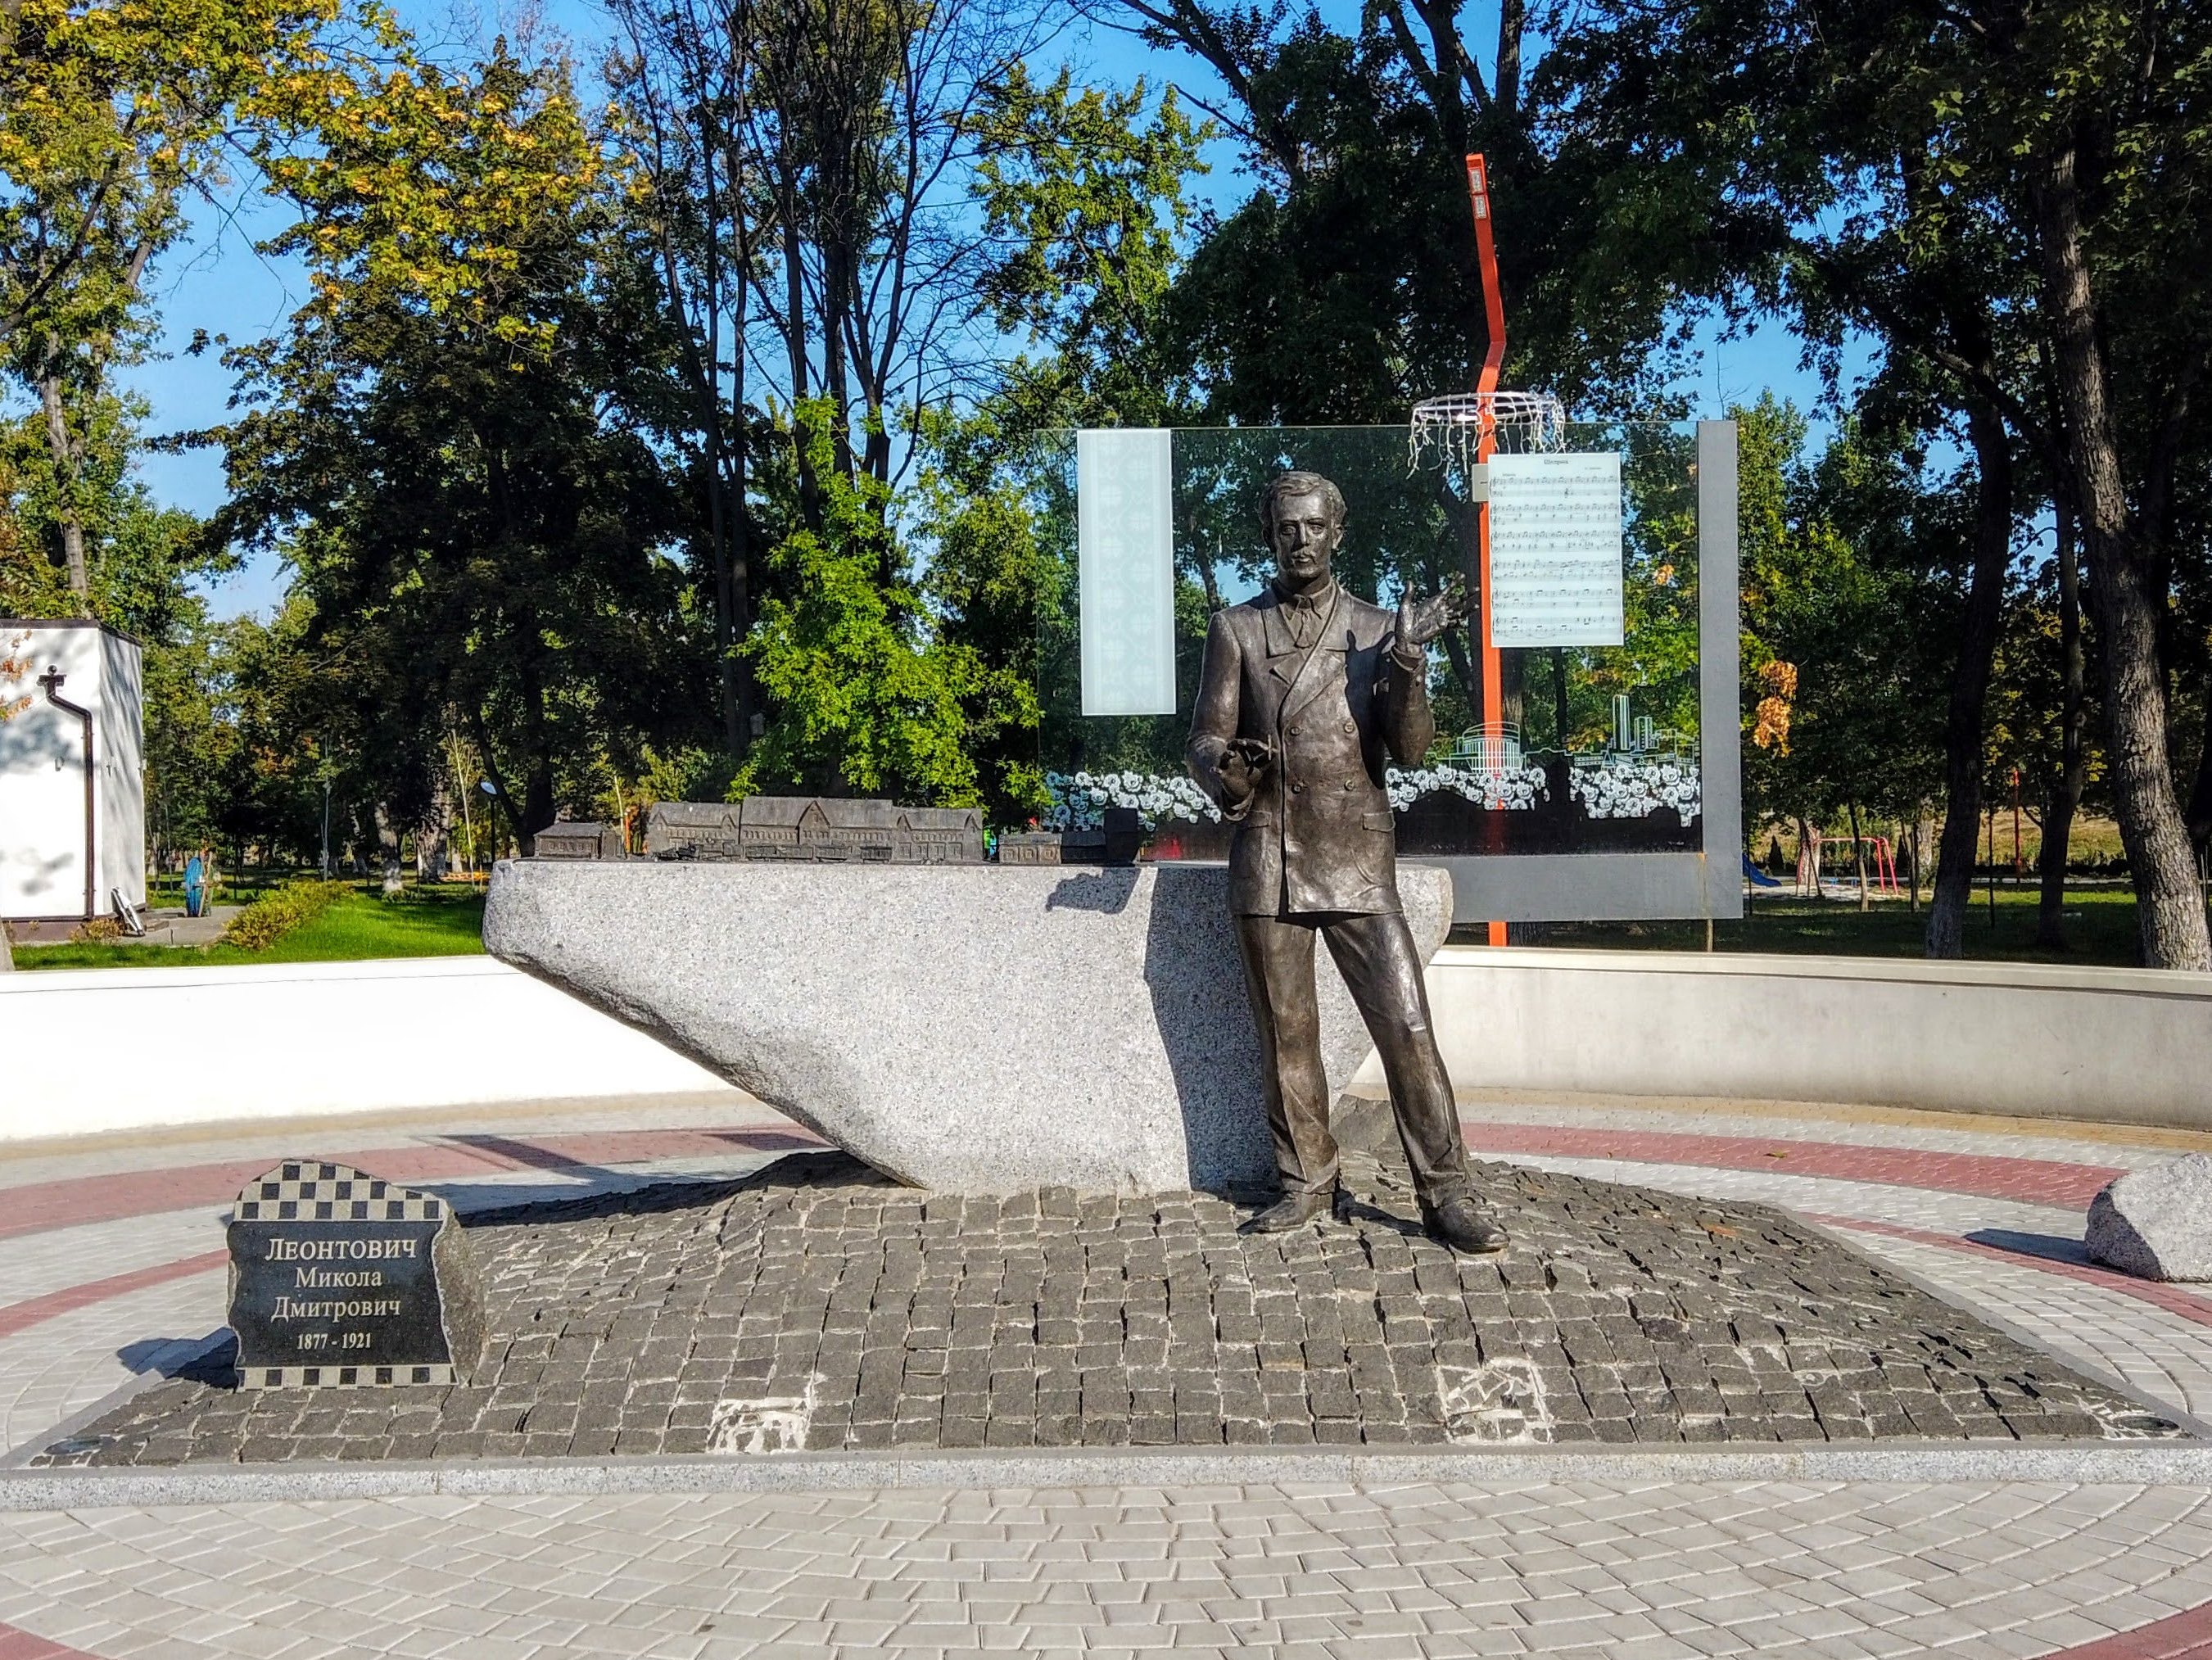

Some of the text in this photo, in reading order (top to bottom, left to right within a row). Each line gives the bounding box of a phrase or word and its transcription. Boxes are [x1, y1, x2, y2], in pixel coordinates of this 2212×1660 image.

[294, 1267, 383, 1288] Микола
[270, 1296, 400, 1323] Дмитрович
[296, 1333, 328, 1350] 1877
[342, 1332, 371, 1349] 1921
